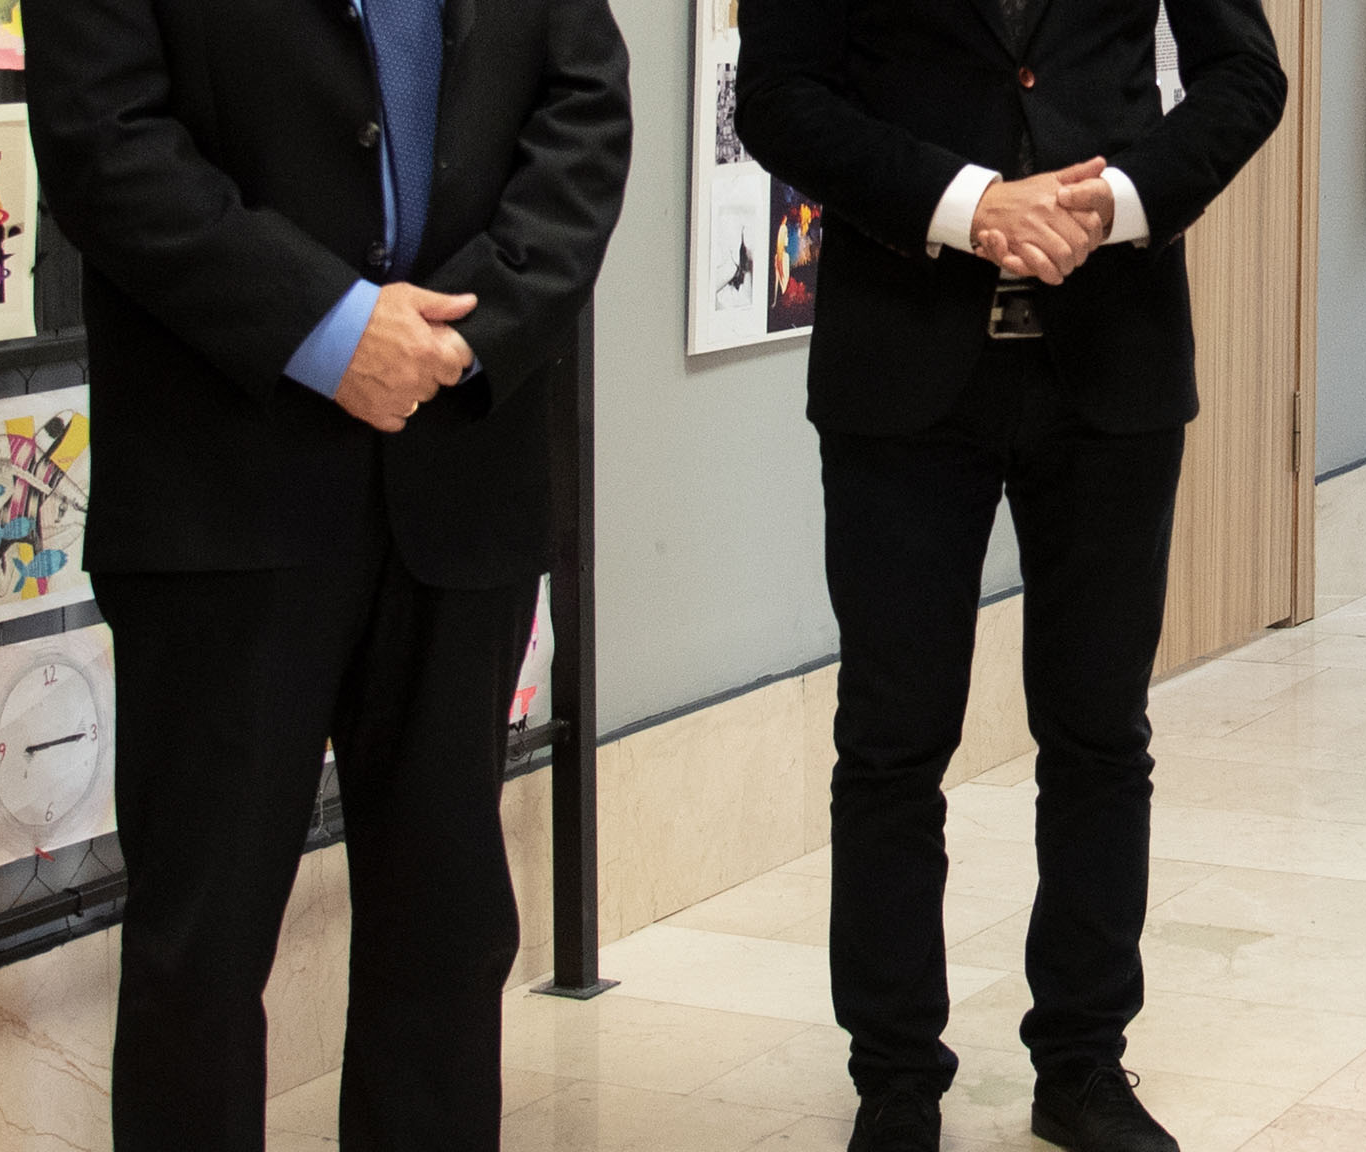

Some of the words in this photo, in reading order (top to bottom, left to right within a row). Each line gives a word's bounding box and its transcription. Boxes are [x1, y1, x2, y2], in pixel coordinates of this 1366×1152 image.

[43, 665, 58, 686] 12
[91, 723, 98, 742] 3
[44, 801, 54, 822] 6
